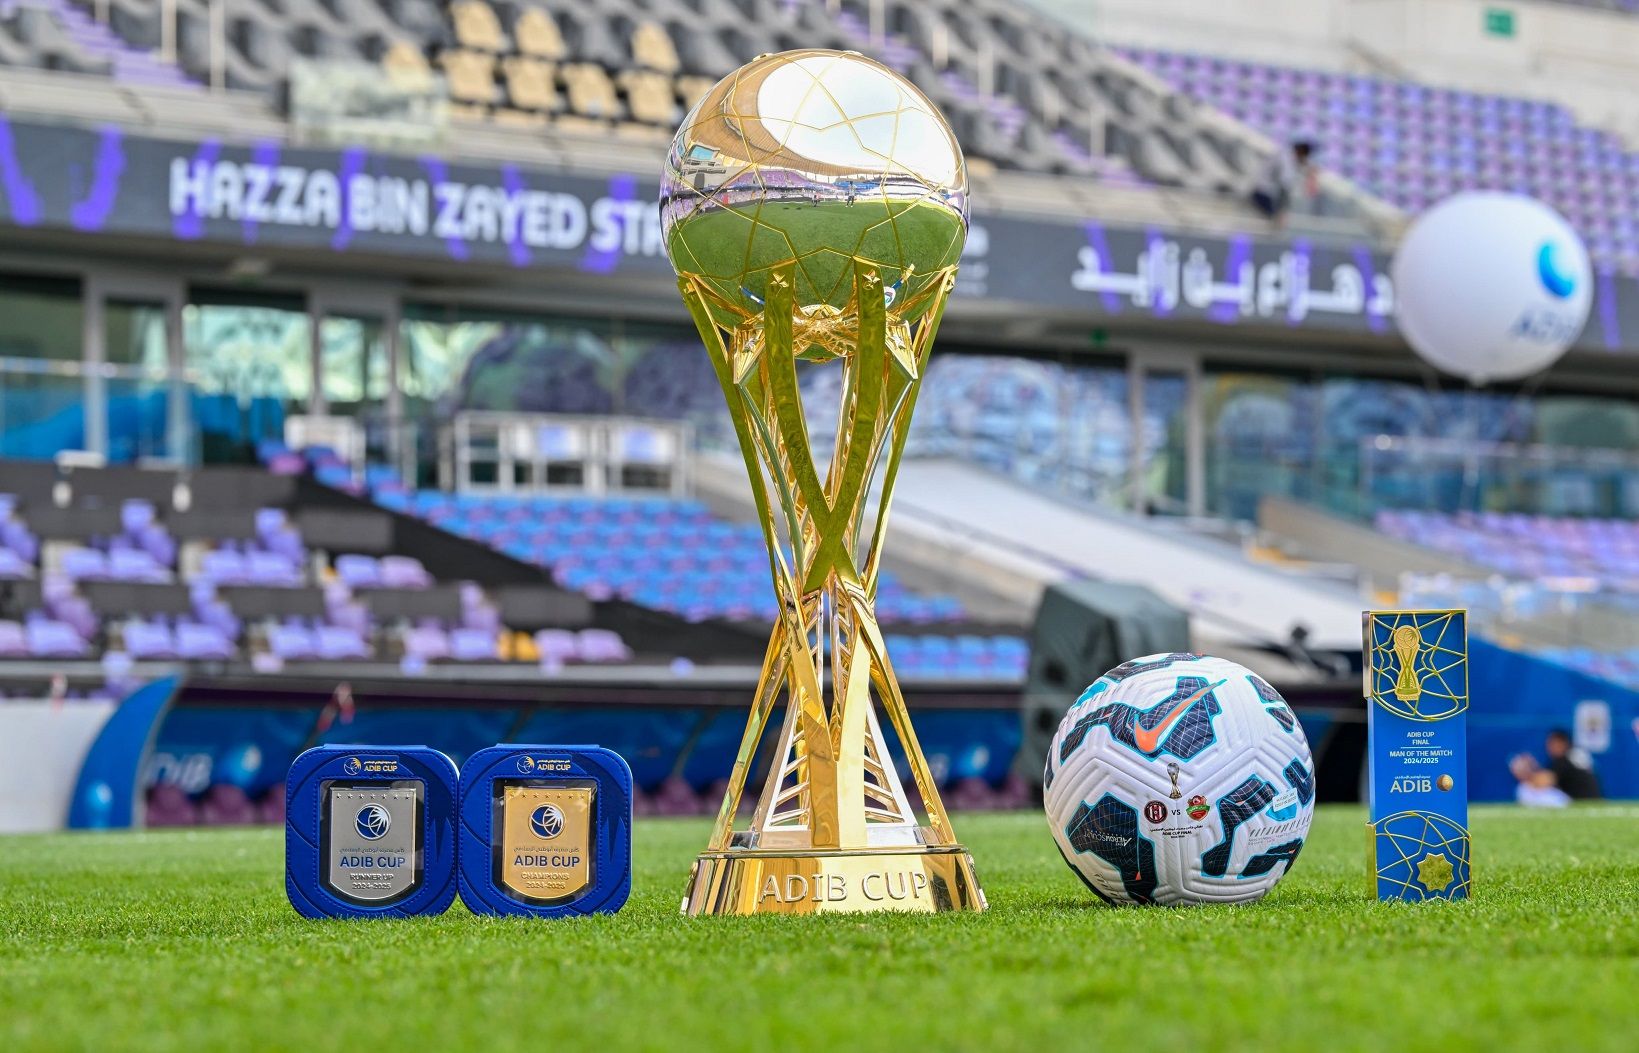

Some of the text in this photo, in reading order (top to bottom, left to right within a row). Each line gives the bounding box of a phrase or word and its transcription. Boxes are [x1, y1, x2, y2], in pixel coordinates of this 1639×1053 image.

[169, 157, 341, 228] HAZZA
[348, 173, 428, 236] BIN
[433, 181, 588, 249] ZAYED
[1390, 779, 1432, 793] ADIB
[340, 856, 405, 868] ADIB CUP
[514, 855, 580, 867] ADIB CUP
[350, 873, 394, 881] RUNNER UP
[521, 872, 570, 881] CHAMPIONS
[352, 882, 391, 890] 2024-2025
[758, 871, 928, 903] ADIB CUP
